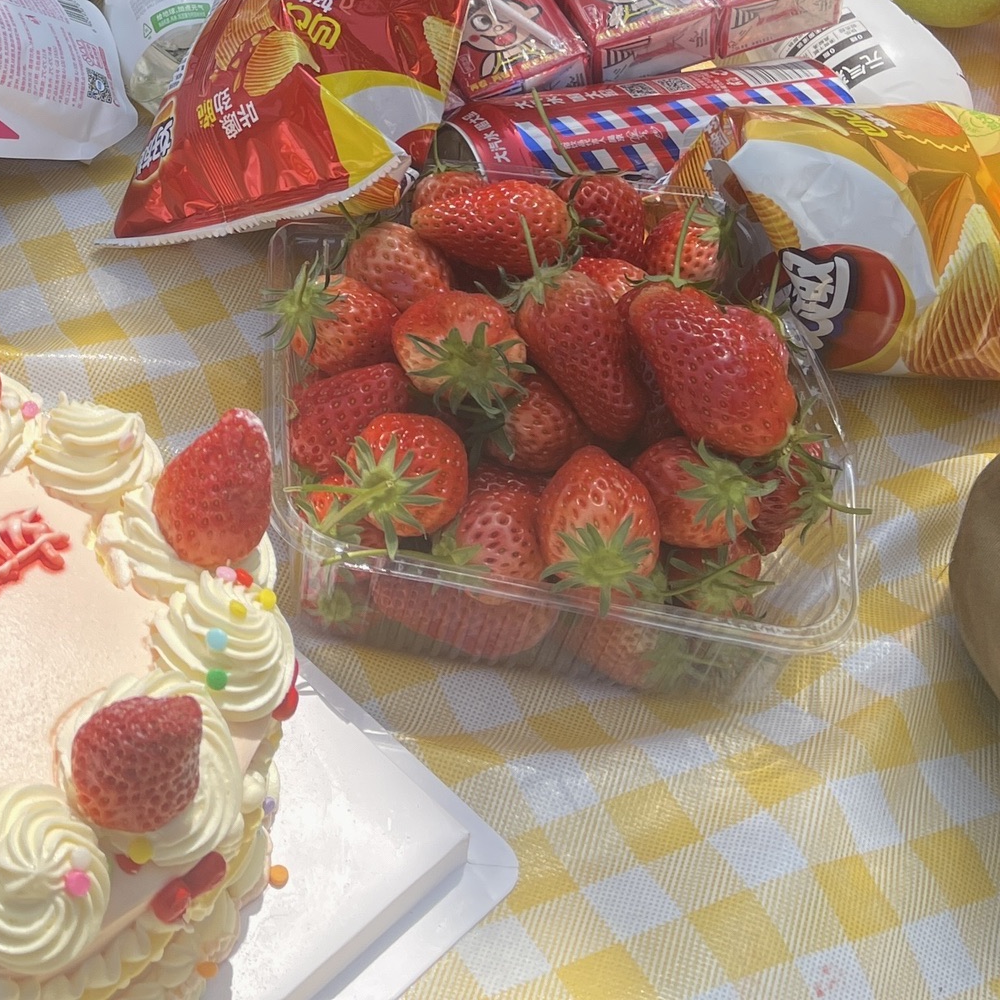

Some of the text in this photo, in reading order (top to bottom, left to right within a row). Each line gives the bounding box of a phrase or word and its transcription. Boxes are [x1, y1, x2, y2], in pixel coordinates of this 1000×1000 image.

[196, 87, 233, 129] 劲脆
[220, 101, 259, 140] 咔嚓
[484, 130, 510, 162] 大汽水
